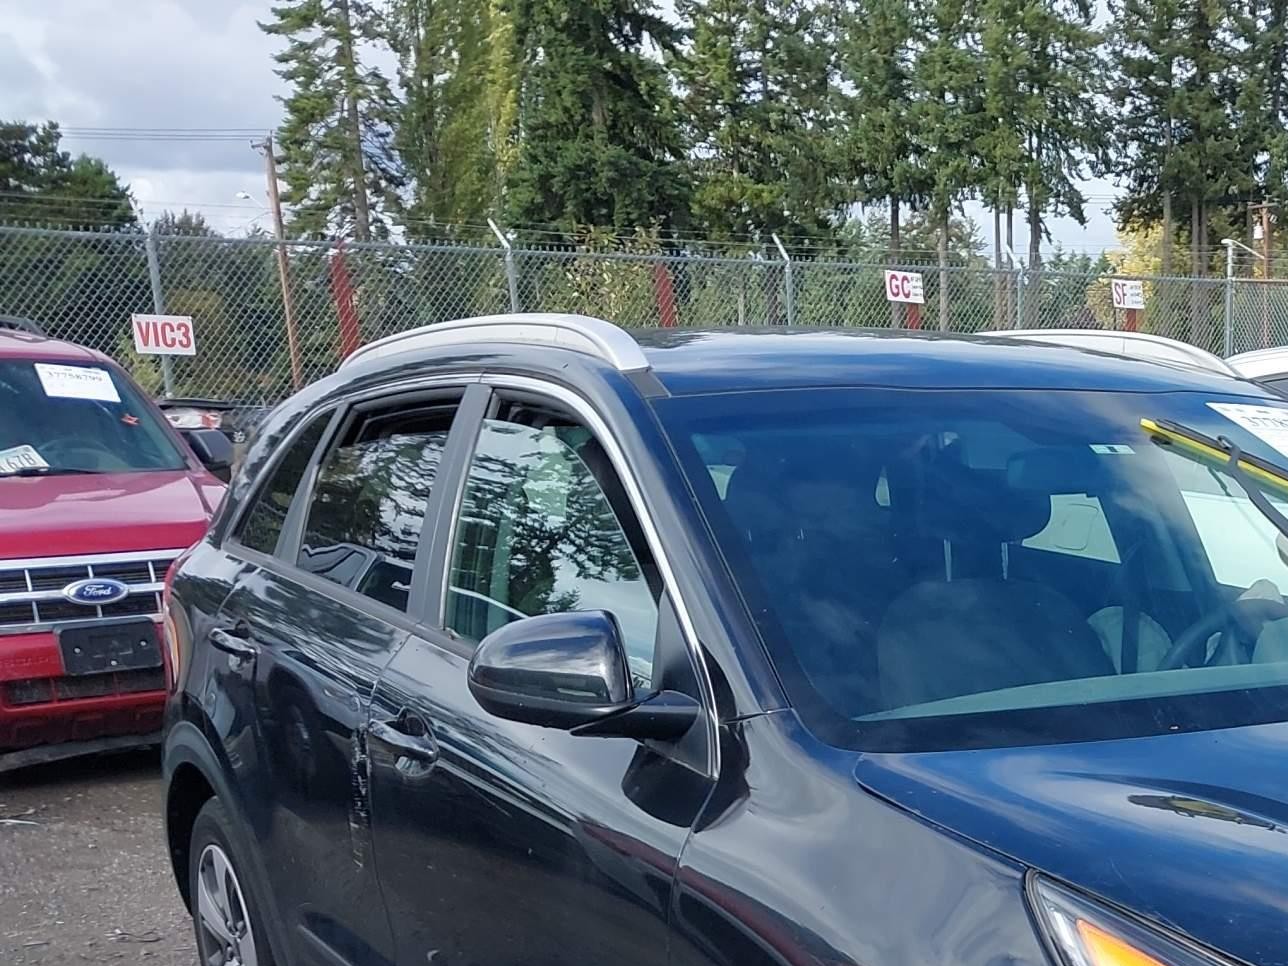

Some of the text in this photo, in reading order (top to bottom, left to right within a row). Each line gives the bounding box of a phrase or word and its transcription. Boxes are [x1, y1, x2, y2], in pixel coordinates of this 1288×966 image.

[889, 273, 912, 299] GC
[1114, 282, 1128, 306] SF
[136, 321, 192, 349] VIC3
[83, 584, 113, 597] Ford
